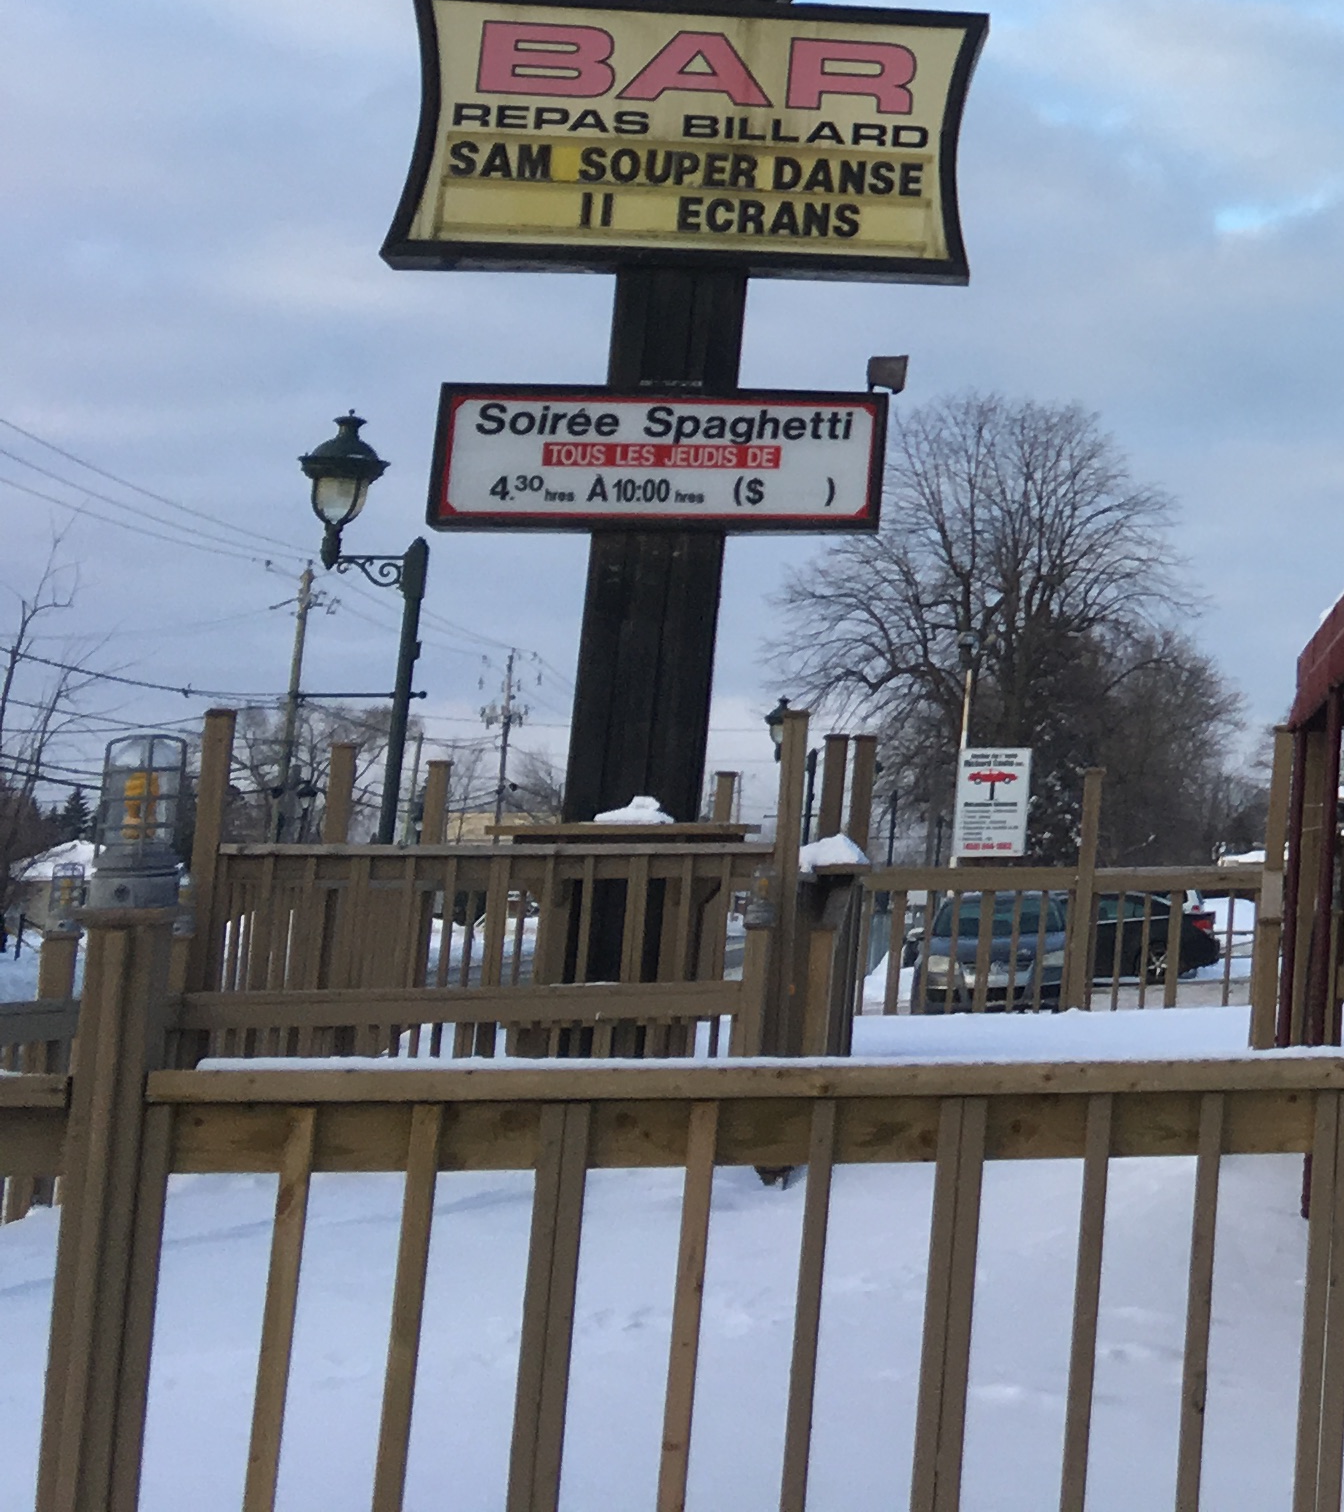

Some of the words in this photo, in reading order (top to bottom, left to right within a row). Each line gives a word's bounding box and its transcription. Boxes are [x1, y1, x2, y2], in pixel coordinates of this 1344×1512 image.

[476, 19, 917, 115] BAR
[452, 102, 651, 135] REPAS
[682, 114, 929, 148] BILLARD
[449, 140, 552, 179] SAM
[578, 146, 758, 187] SOUPER
[773, 156, 924, 196] DANSE
[677, 197, 861, 238] ECRANS
[475, 402, 620, 437] Soirée
[643, 406, 853, 445] Spaghetti
[549, 445, 606, 465] TOUS
[615, 446, 656, 466] LES
[664, 447, 738, 467] JEUDIS
[747, 448, 775, 467] DE
[612, 478, 671, 503] 10:00
